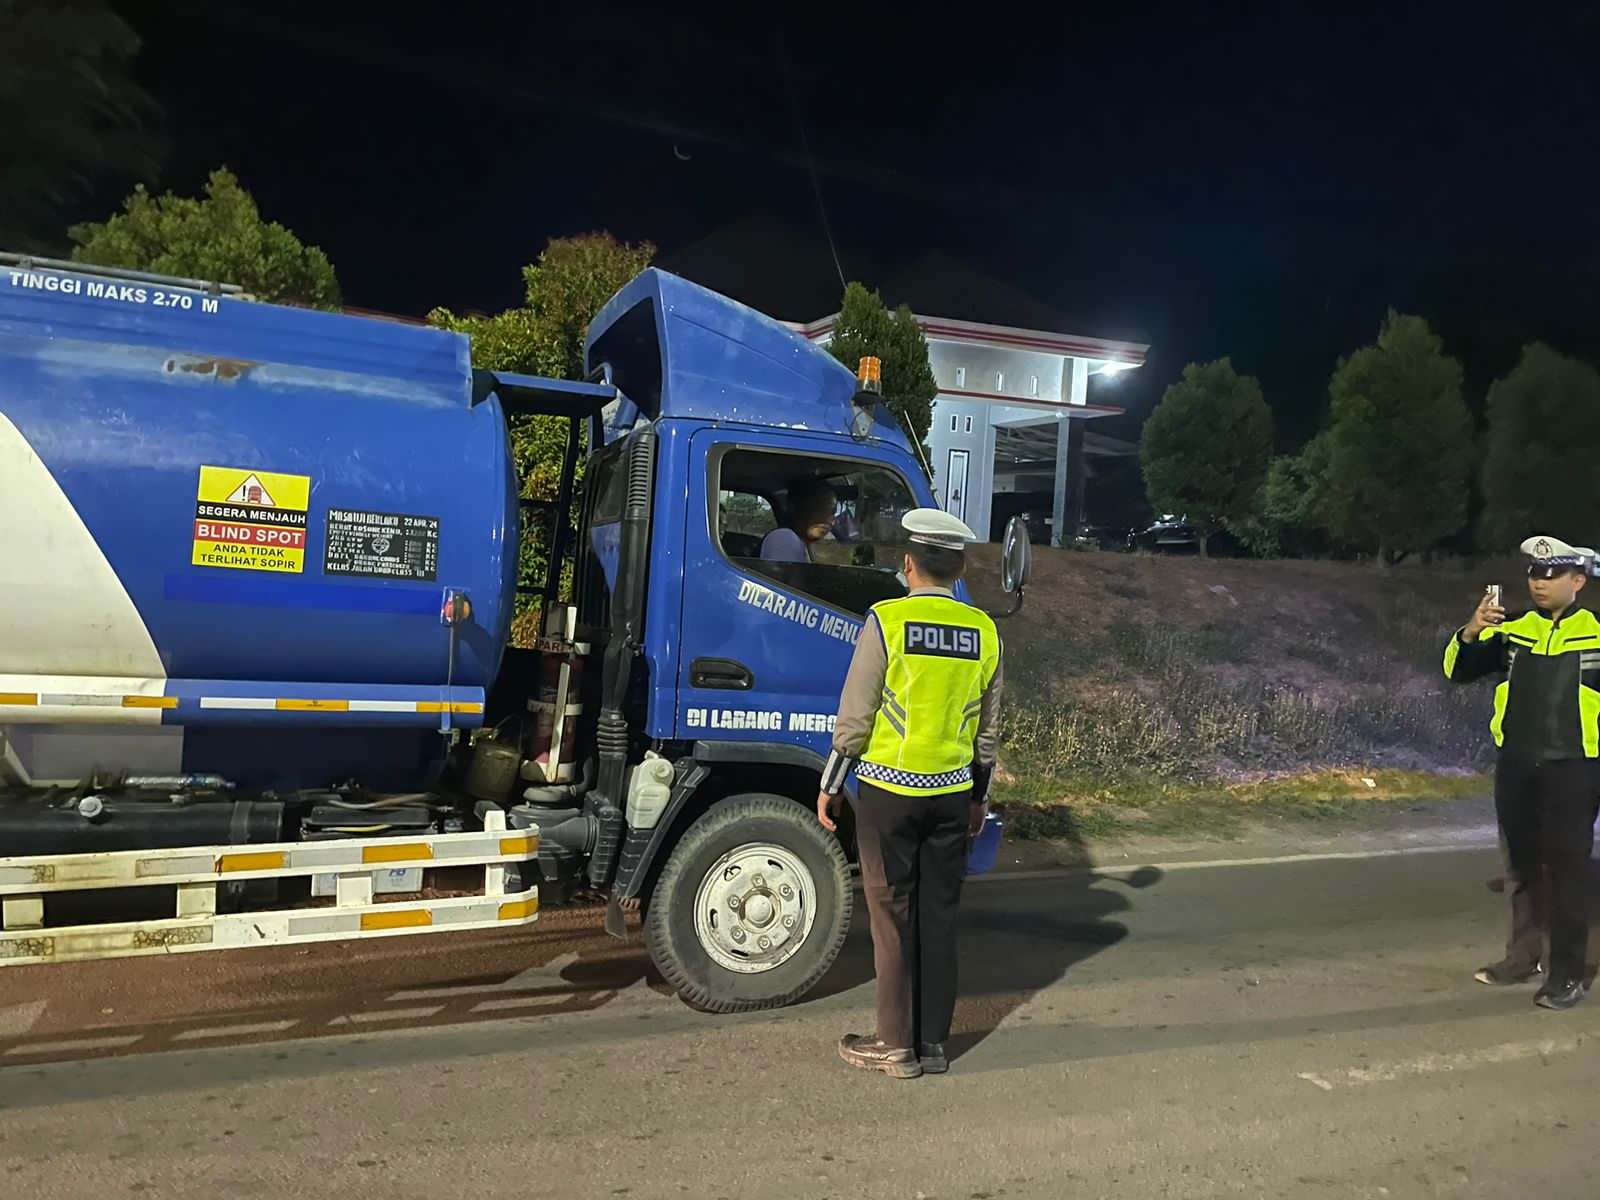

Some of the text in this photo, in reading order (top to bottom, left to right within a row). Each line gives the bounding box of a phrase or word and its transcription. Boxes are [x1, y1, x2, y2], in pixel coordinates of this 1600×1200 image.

[10, 271, 81, 294] TINGGI
[87, 282, 147, 303] MAKS
[202, 299, 218, 313] M
[198, 505, 306, 524] SEGERA MENJAUH
[198, 524, 302, 545] BLIND SPOT
[213, 544, 285, 557] ANDA TIDAK
[201, 554, 296, 569] TERLIHAT SOPIR
[738, 581, 819, 628] DILARANG
[908, 625, 978, 654] POLISI
[687, 708, 708, 727] DI
[711, 709, 782, 730] LARANG
